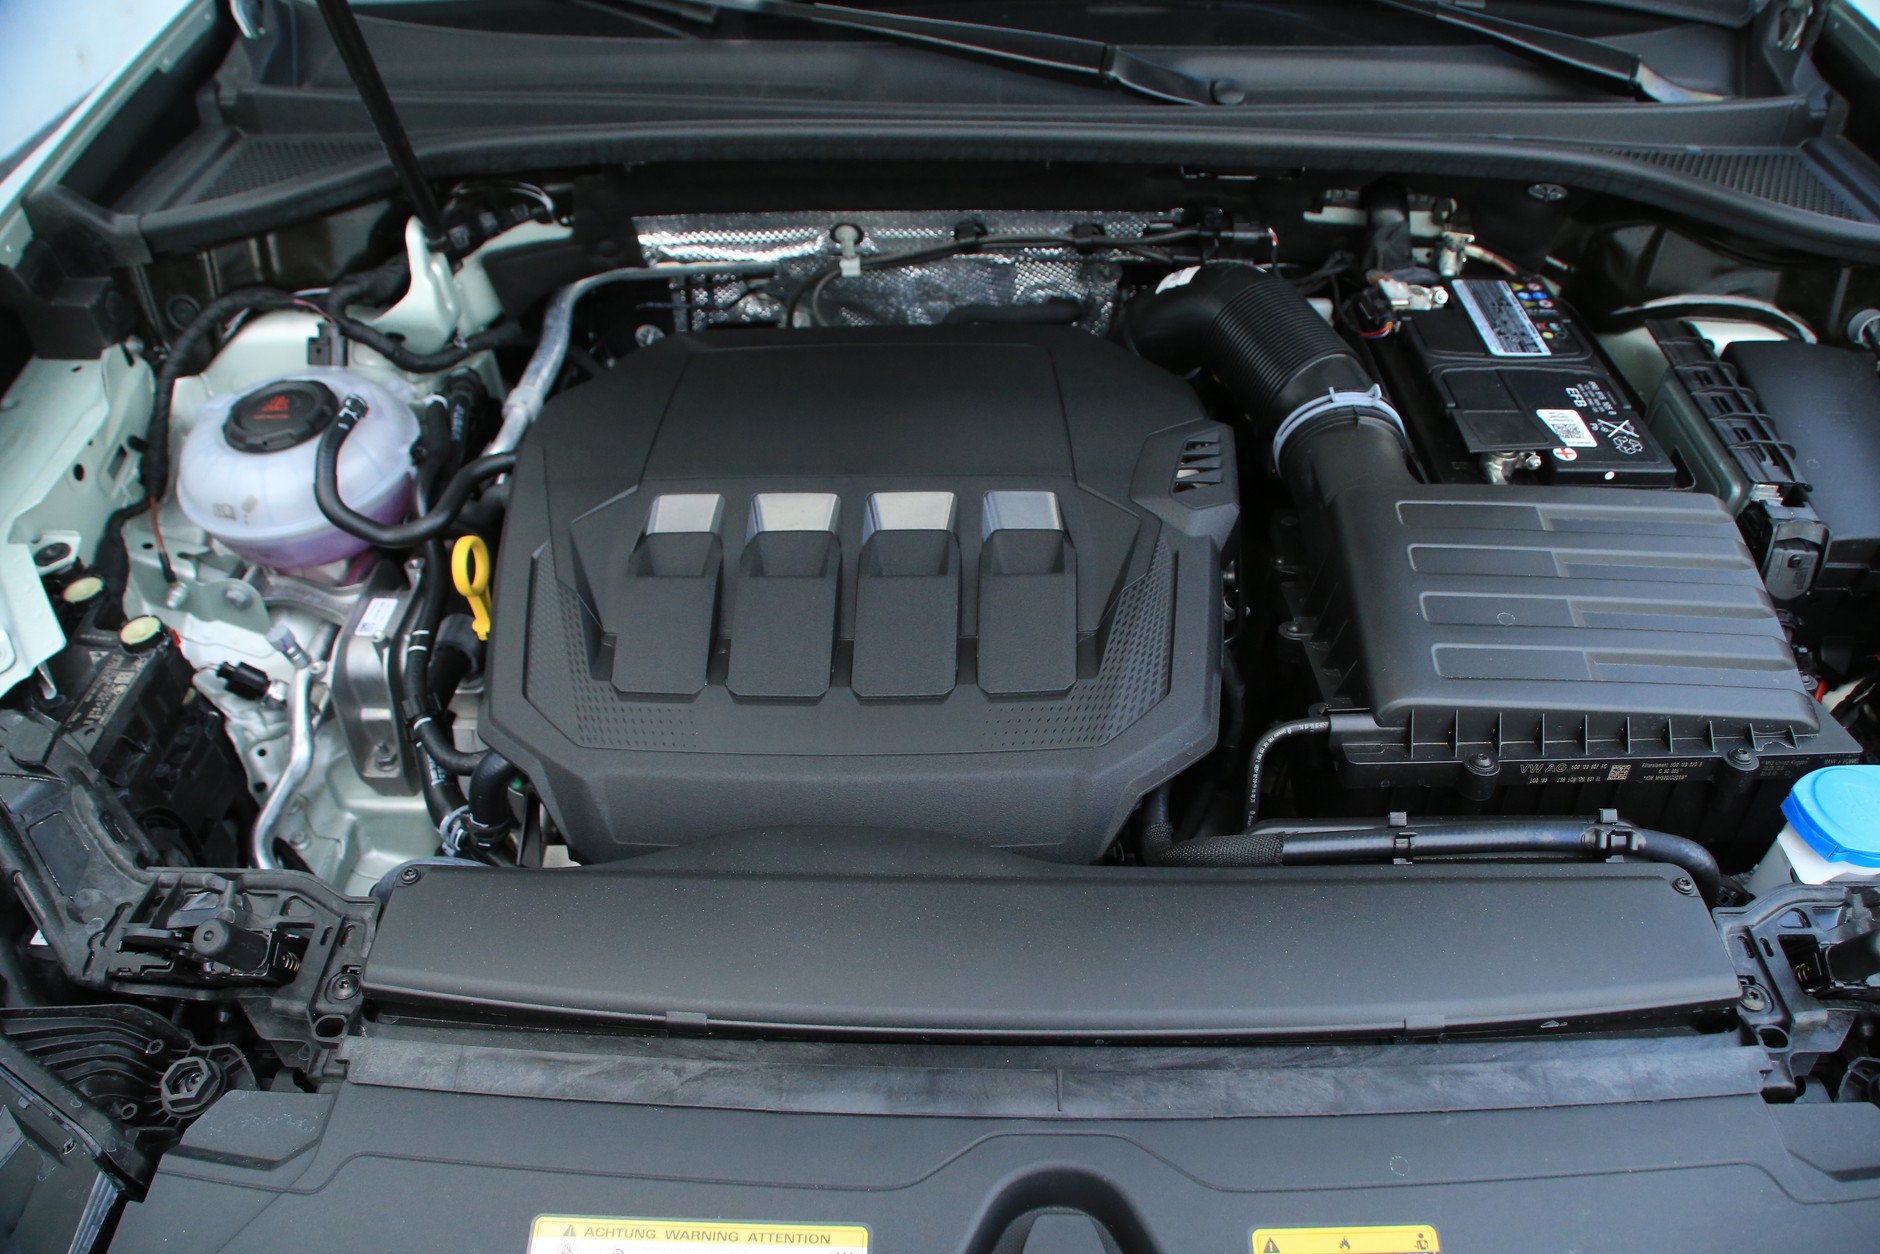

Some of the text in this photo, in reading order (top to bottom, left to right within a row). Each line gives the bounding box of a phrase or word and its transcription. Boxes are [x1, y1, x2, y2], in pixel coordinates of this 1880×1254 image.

[1565, 387, 1588, 408] EFB
[1519, 762, 1568, 774] VW AG
[584, 1226, 831, 1245] ACHTUNG WARNING ATTENTION
